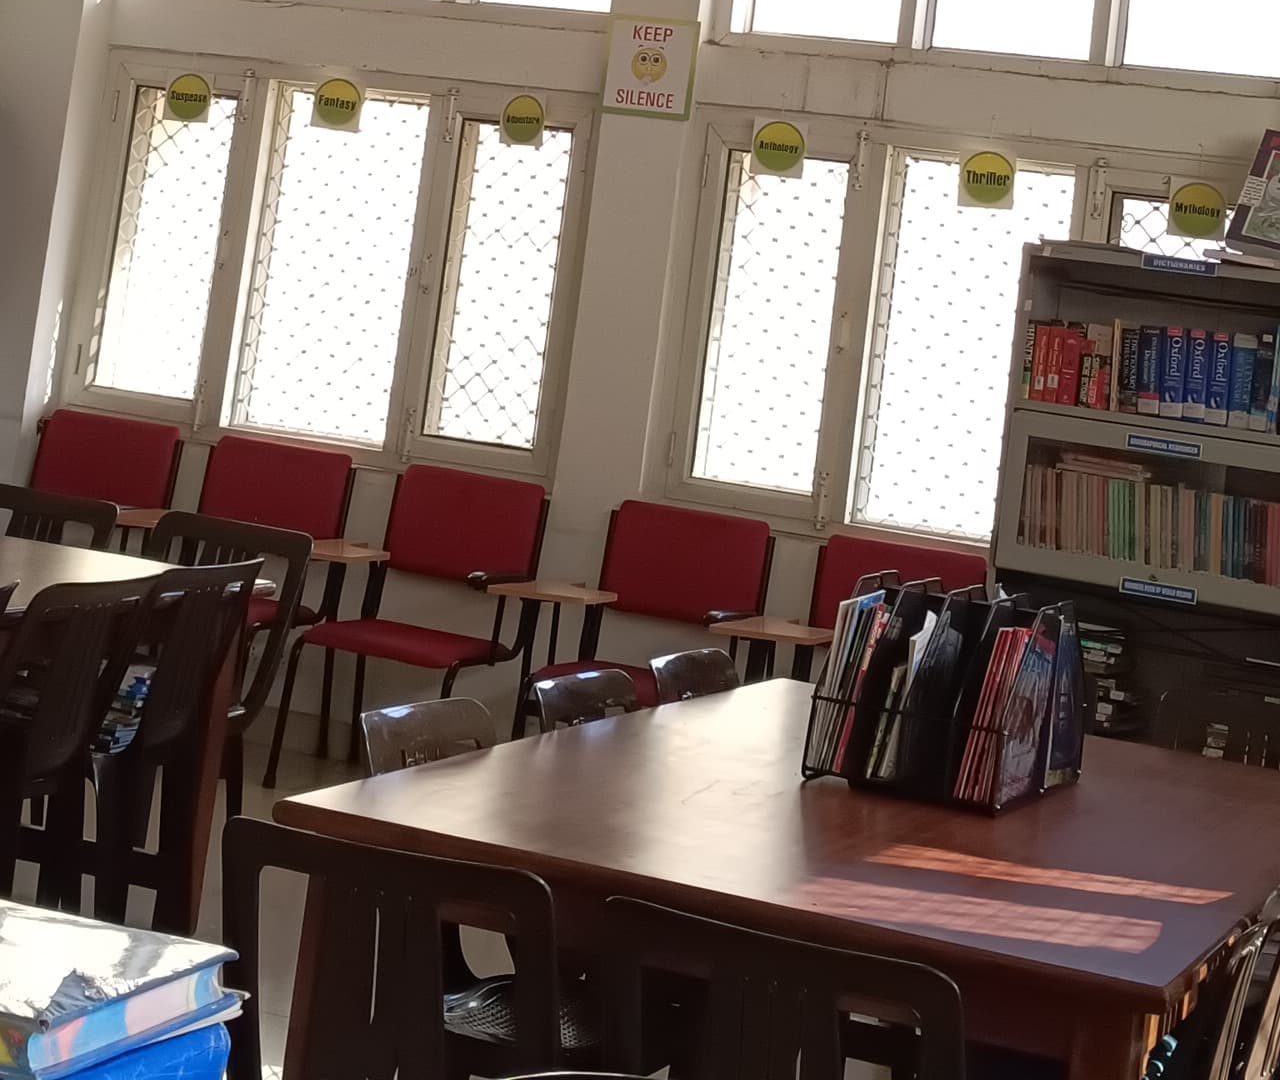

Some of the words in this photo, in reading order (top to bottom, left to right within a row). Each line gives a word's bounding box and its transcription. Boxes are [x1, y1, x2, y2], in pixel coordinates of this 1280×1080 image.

[632, 25, 673, 43] KEEP
[318, 94, 357, 112] Fantasy
[615, 88, 674, 109] SILENCE
[759, 139, 800, 155] Anthology
[966, 170, 1010, 187] Thriller
[1174, 201, 1221, 218] Mythology
[1152, 258, 1206, 272] DICTIONARIES
[1169, 337, 1182, 376] Oxford
[1192, 339, 1205, 379] Oxford
[1215, 342, 1229, 381] Oxford
